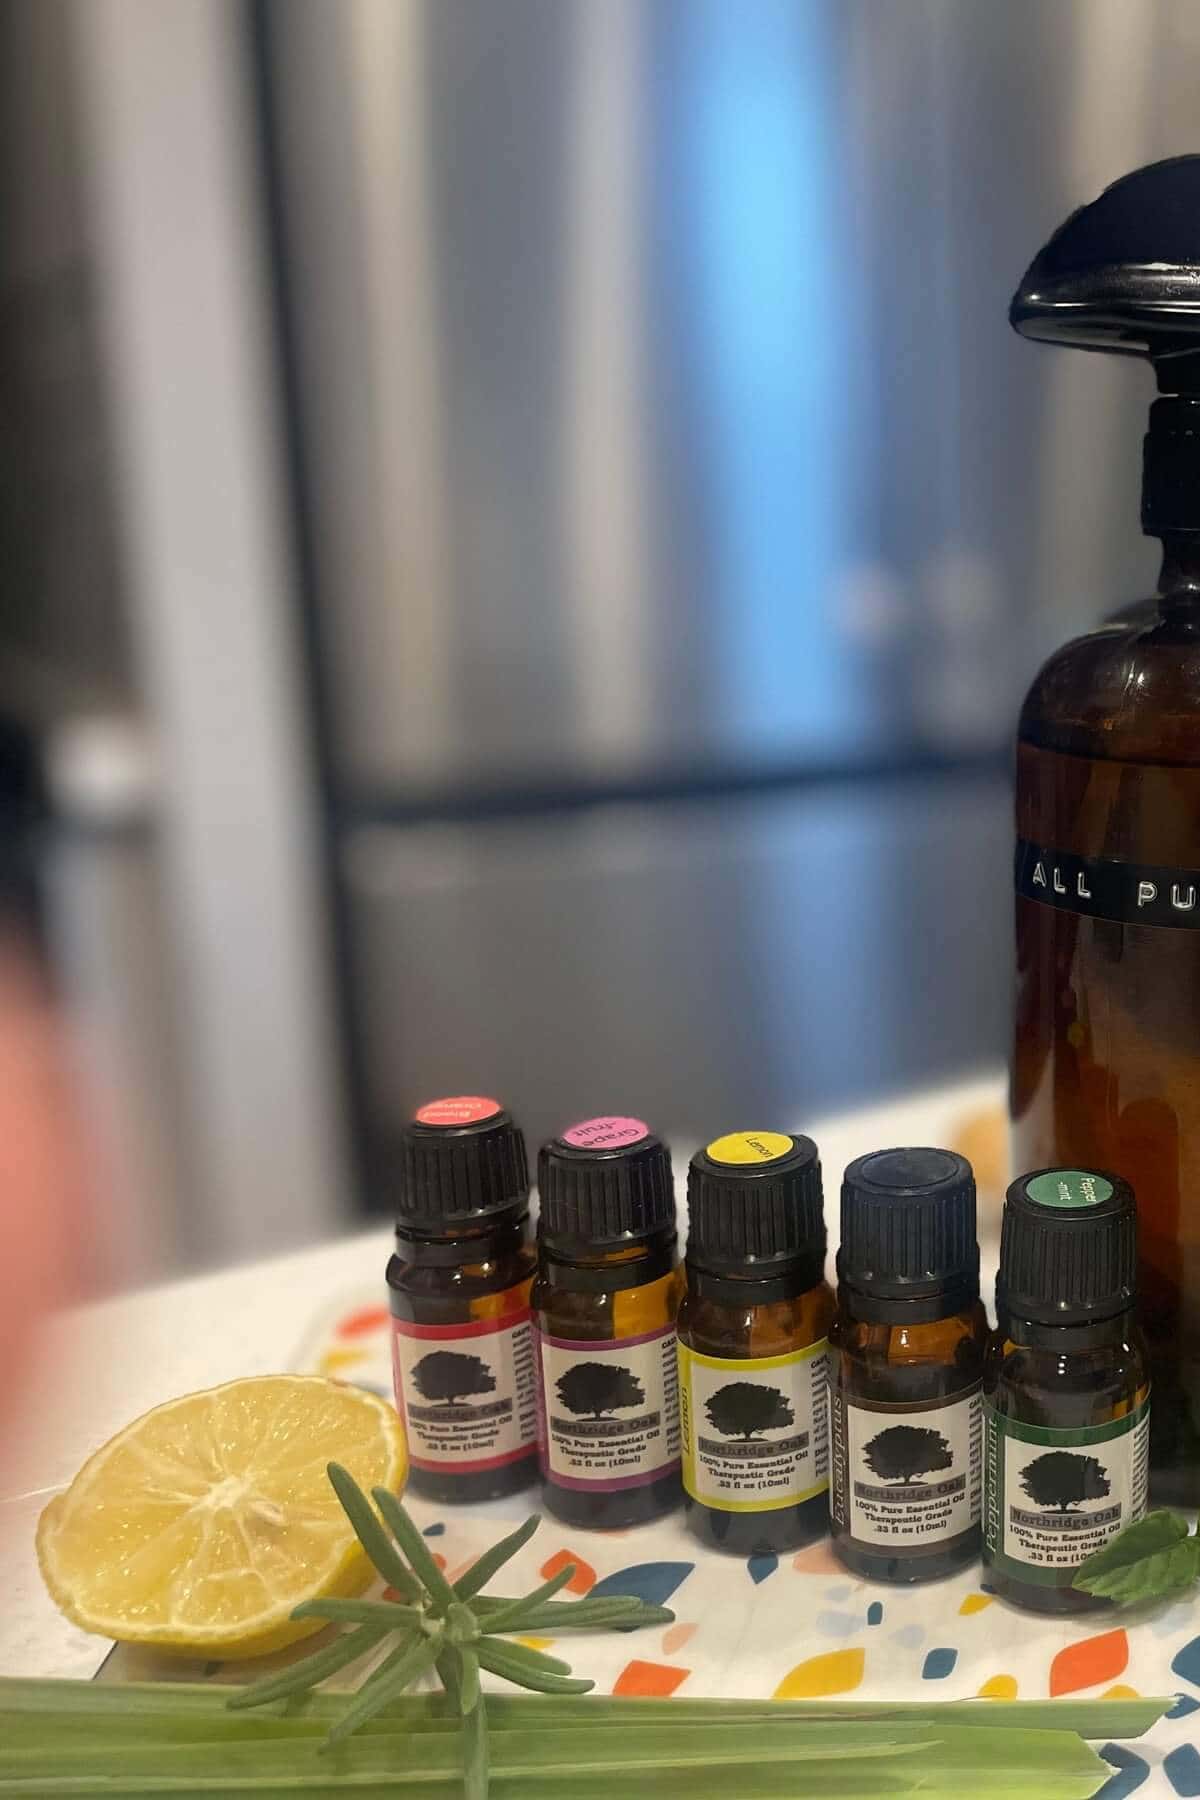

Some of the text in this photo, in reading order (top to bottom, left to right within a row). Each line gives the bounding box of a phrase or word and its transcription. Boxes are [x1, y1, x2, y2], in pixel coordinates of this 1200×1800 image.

[1032, 862, 1092, 899] ALL
[582, 1128, 640, 1146] Grape
[745, 1137, 774, 1158] Lemon
[1080, 1177, 1097, 1202] Pepper
[598, 1435, 644, 1447] Essential
[646, 1429, 660, 1439] Oil
[618, 1445, 646, 1455] Grade
[609, 1456, 641, 1467] (10ml)
[700, 1450, 808, 1469] 100% Pure Essential Oil
[833, 1394, 846, 1526] Eucalyptus
[767, 1466, 795, 1476] Grade
[758, 1477, 789, 1490] (10ml)
[986, 1417, 1000, 1553] Peppermint
[856, 1492, 965, 1514] 100% Pure Essential Oil
[865, 1509, 953, 1525] Therapeutic Grade
[1011, 1507, 1120, 1529] Northridge Oak
[892, 1525, 899, 1533] fl
[916, 1520, 947, 1534] (10ml)
[1010, 1523, 1120, 1542] 100% Pure Essential Oil
[1019, 1538, 1108, 1552] Therapeutic Grade
[1028, 1552, 1043, 1561] .33
